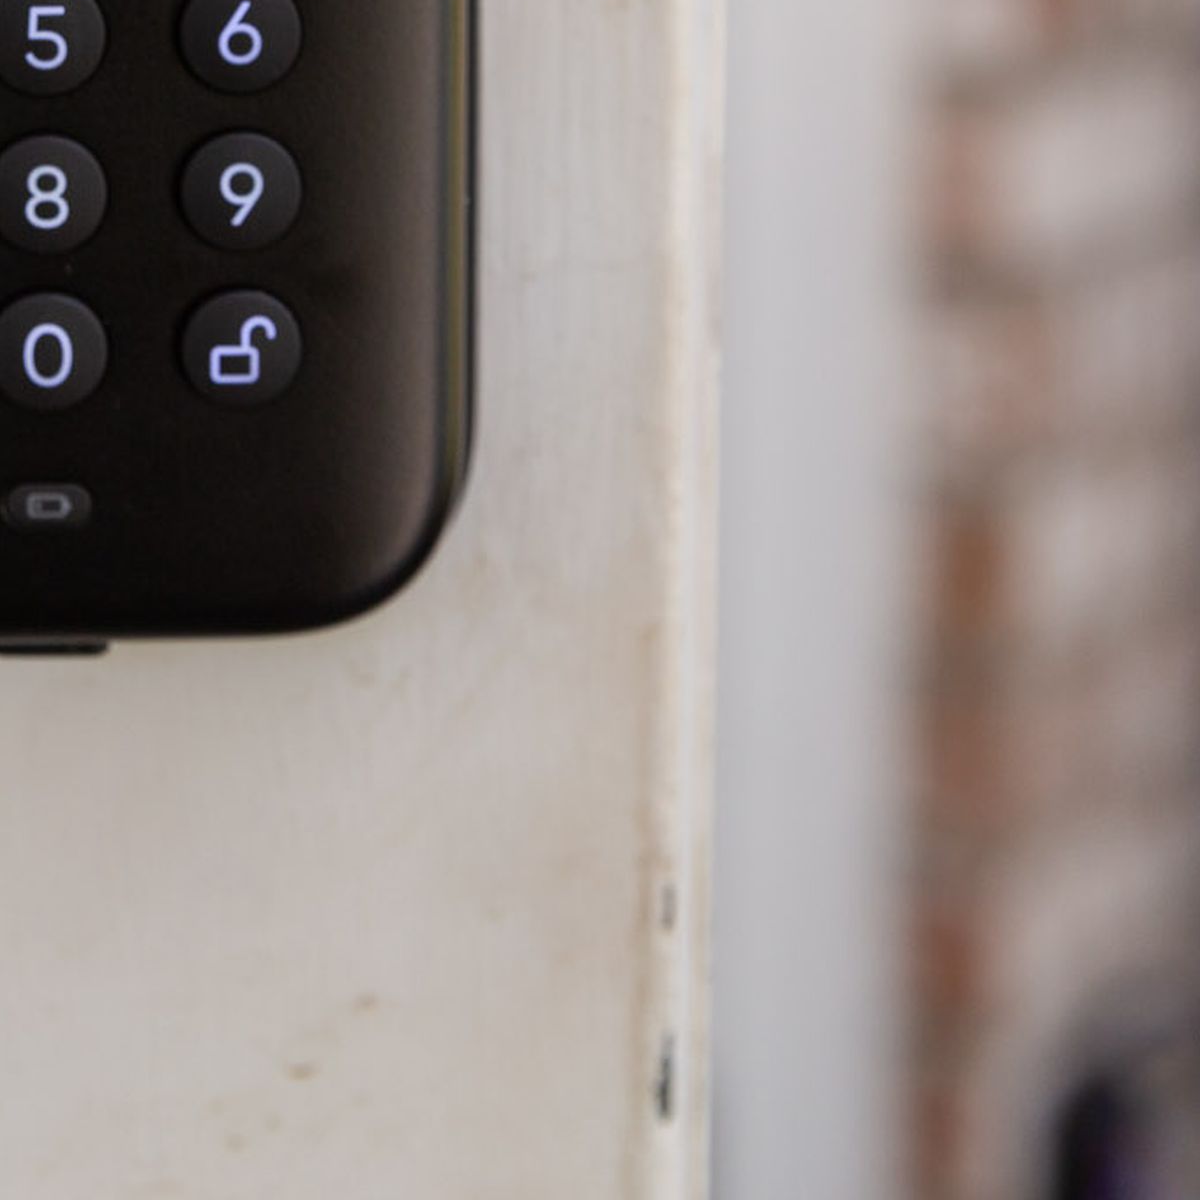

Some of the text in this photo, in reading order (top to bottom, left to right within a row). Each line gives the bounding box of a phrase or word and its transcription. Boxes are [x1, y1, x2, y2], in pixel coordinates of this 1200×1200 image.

[25, 5, 68, 70] 5
[218, 0, 263, 65] 6
[24, 164, 70, 229] 8
[219, 162, 264, 227] 9
[23, 322, 73, 388] 0
